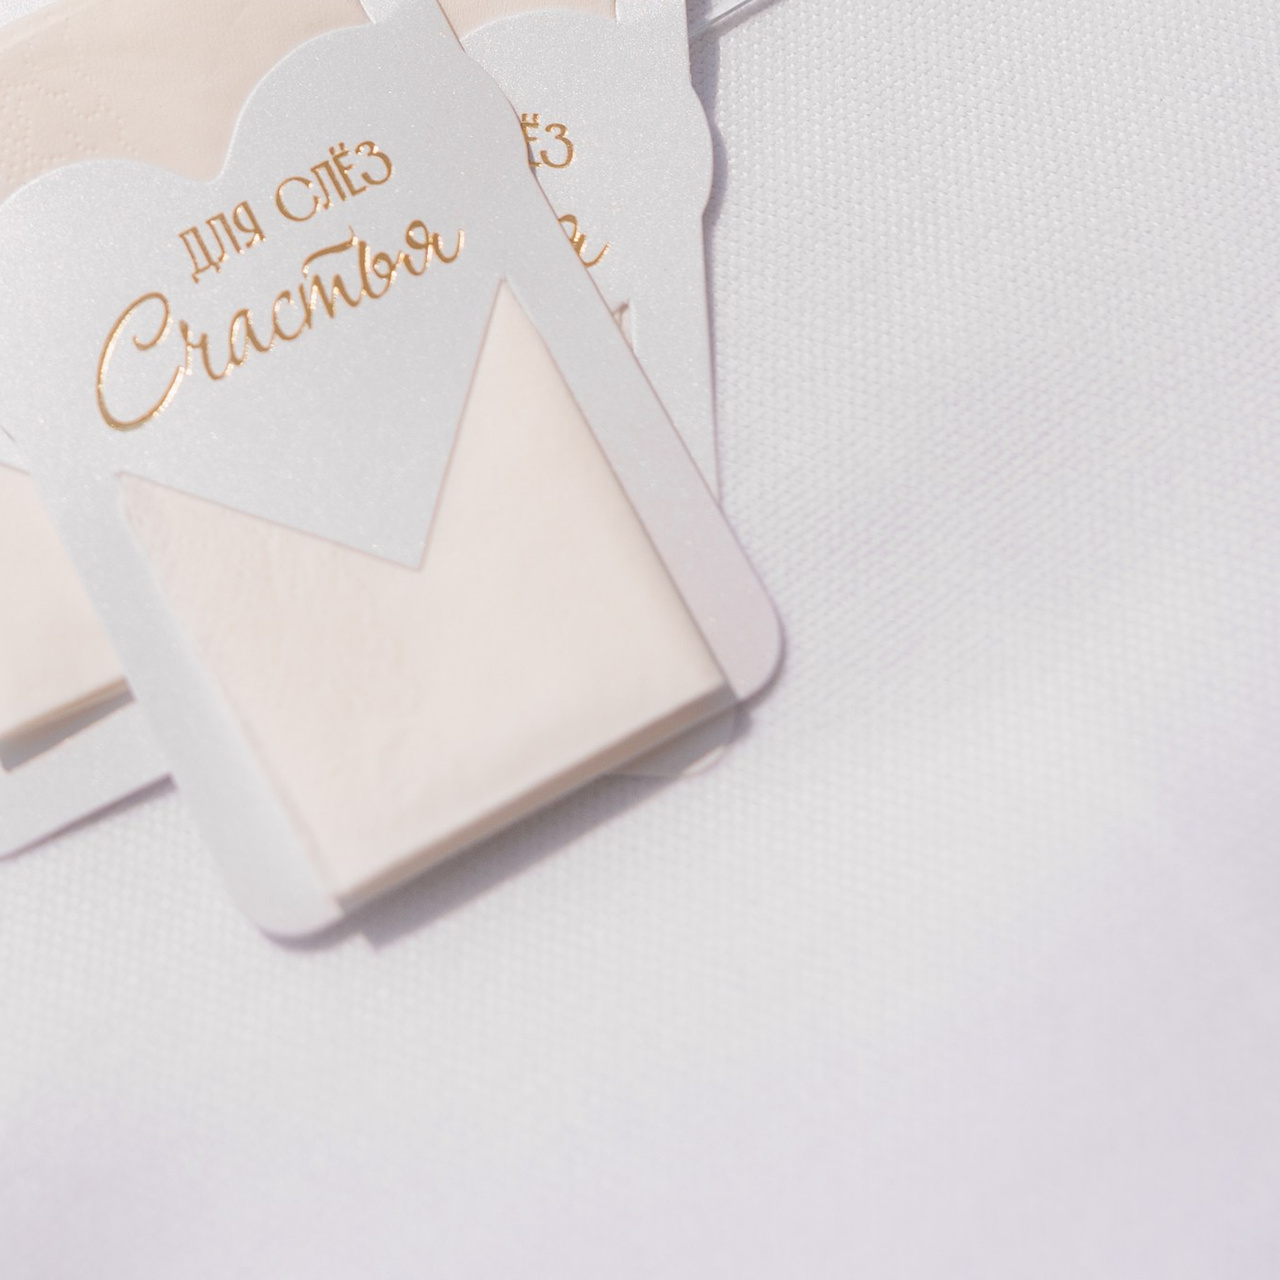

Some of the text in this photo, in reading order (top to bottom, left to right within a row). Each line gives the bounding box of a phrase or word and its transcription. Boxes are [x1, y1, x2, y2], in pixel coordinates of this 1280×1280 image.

[178, 140, 393, 283] ДЛЯ СЛЁЗ
[520, 113, 575, 169] ЁЗ
[96, 219, 465, 432] Счастья
